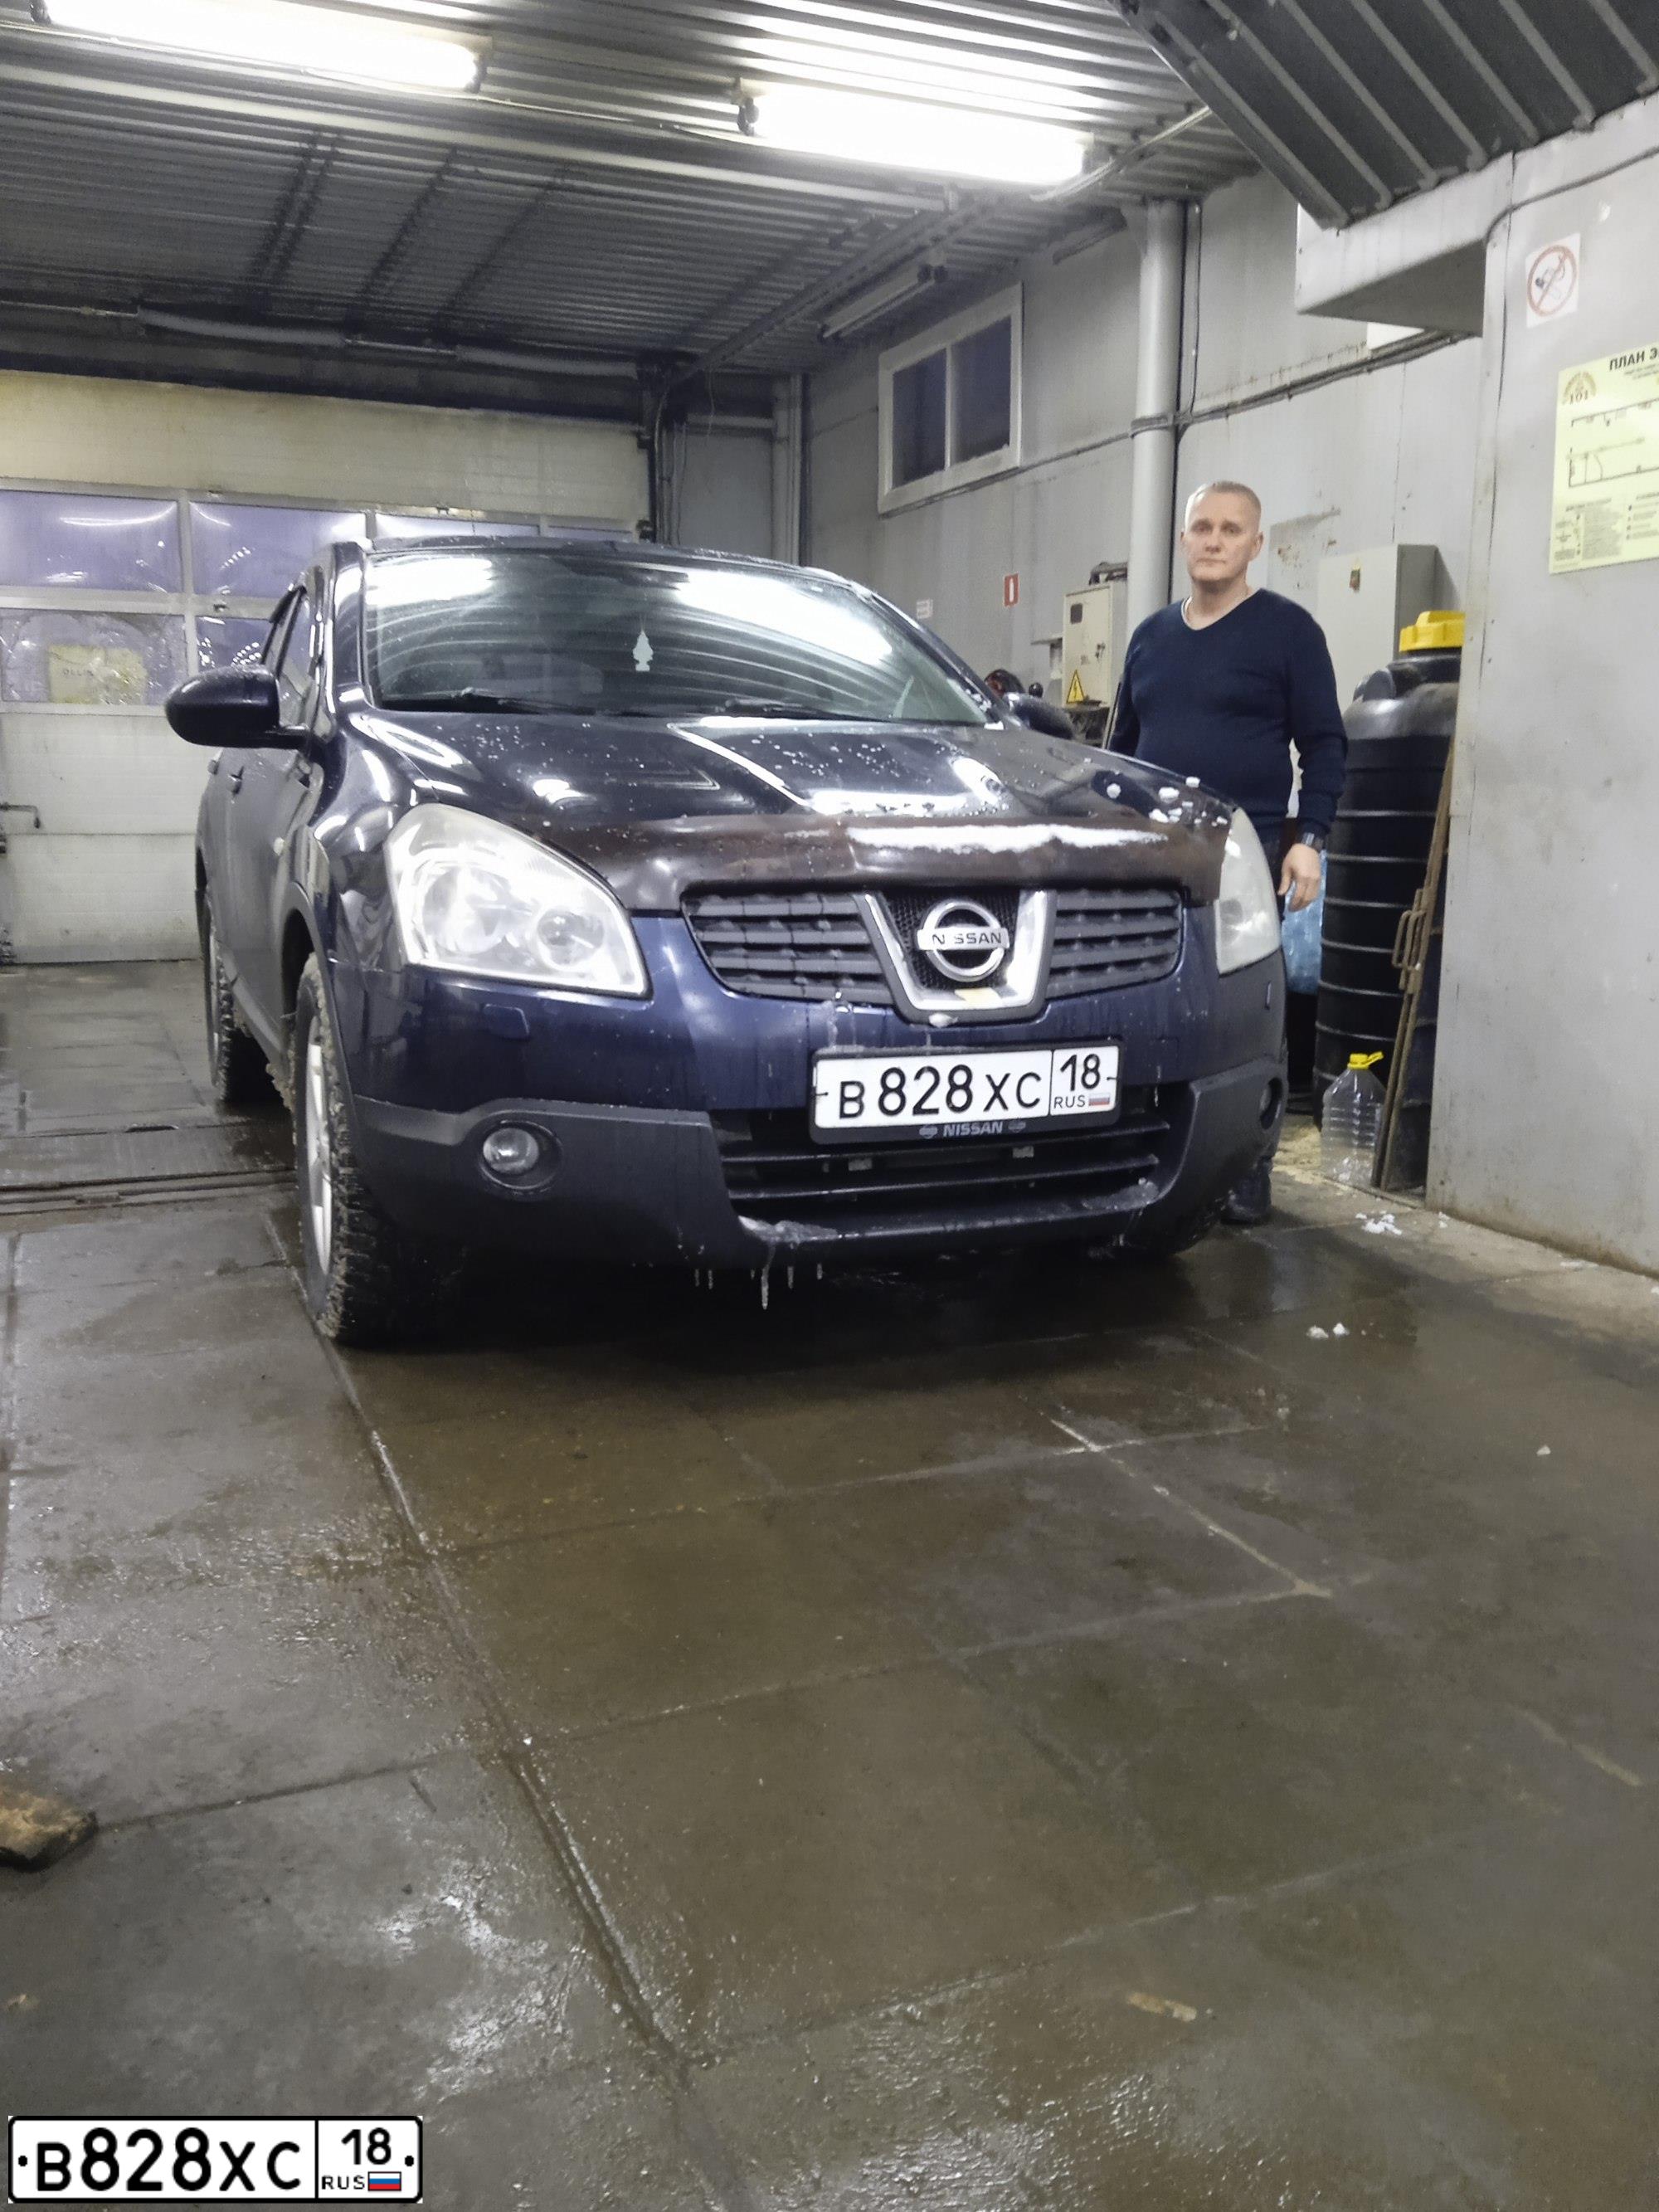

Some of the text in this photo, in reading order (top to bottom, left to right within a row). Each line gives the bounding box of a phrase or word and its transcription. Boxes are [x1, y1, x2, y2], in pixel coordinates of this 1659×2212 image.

[1609, 347, 1659, 371] ПЛАН Э
[932, 933, 1002, 945] NSSAN
[1059, 1053, 1101, 1092] 18
[1053, 1094, 1086, 1108] RUS
[942, 1121, 1004, 1137] NISSAN
